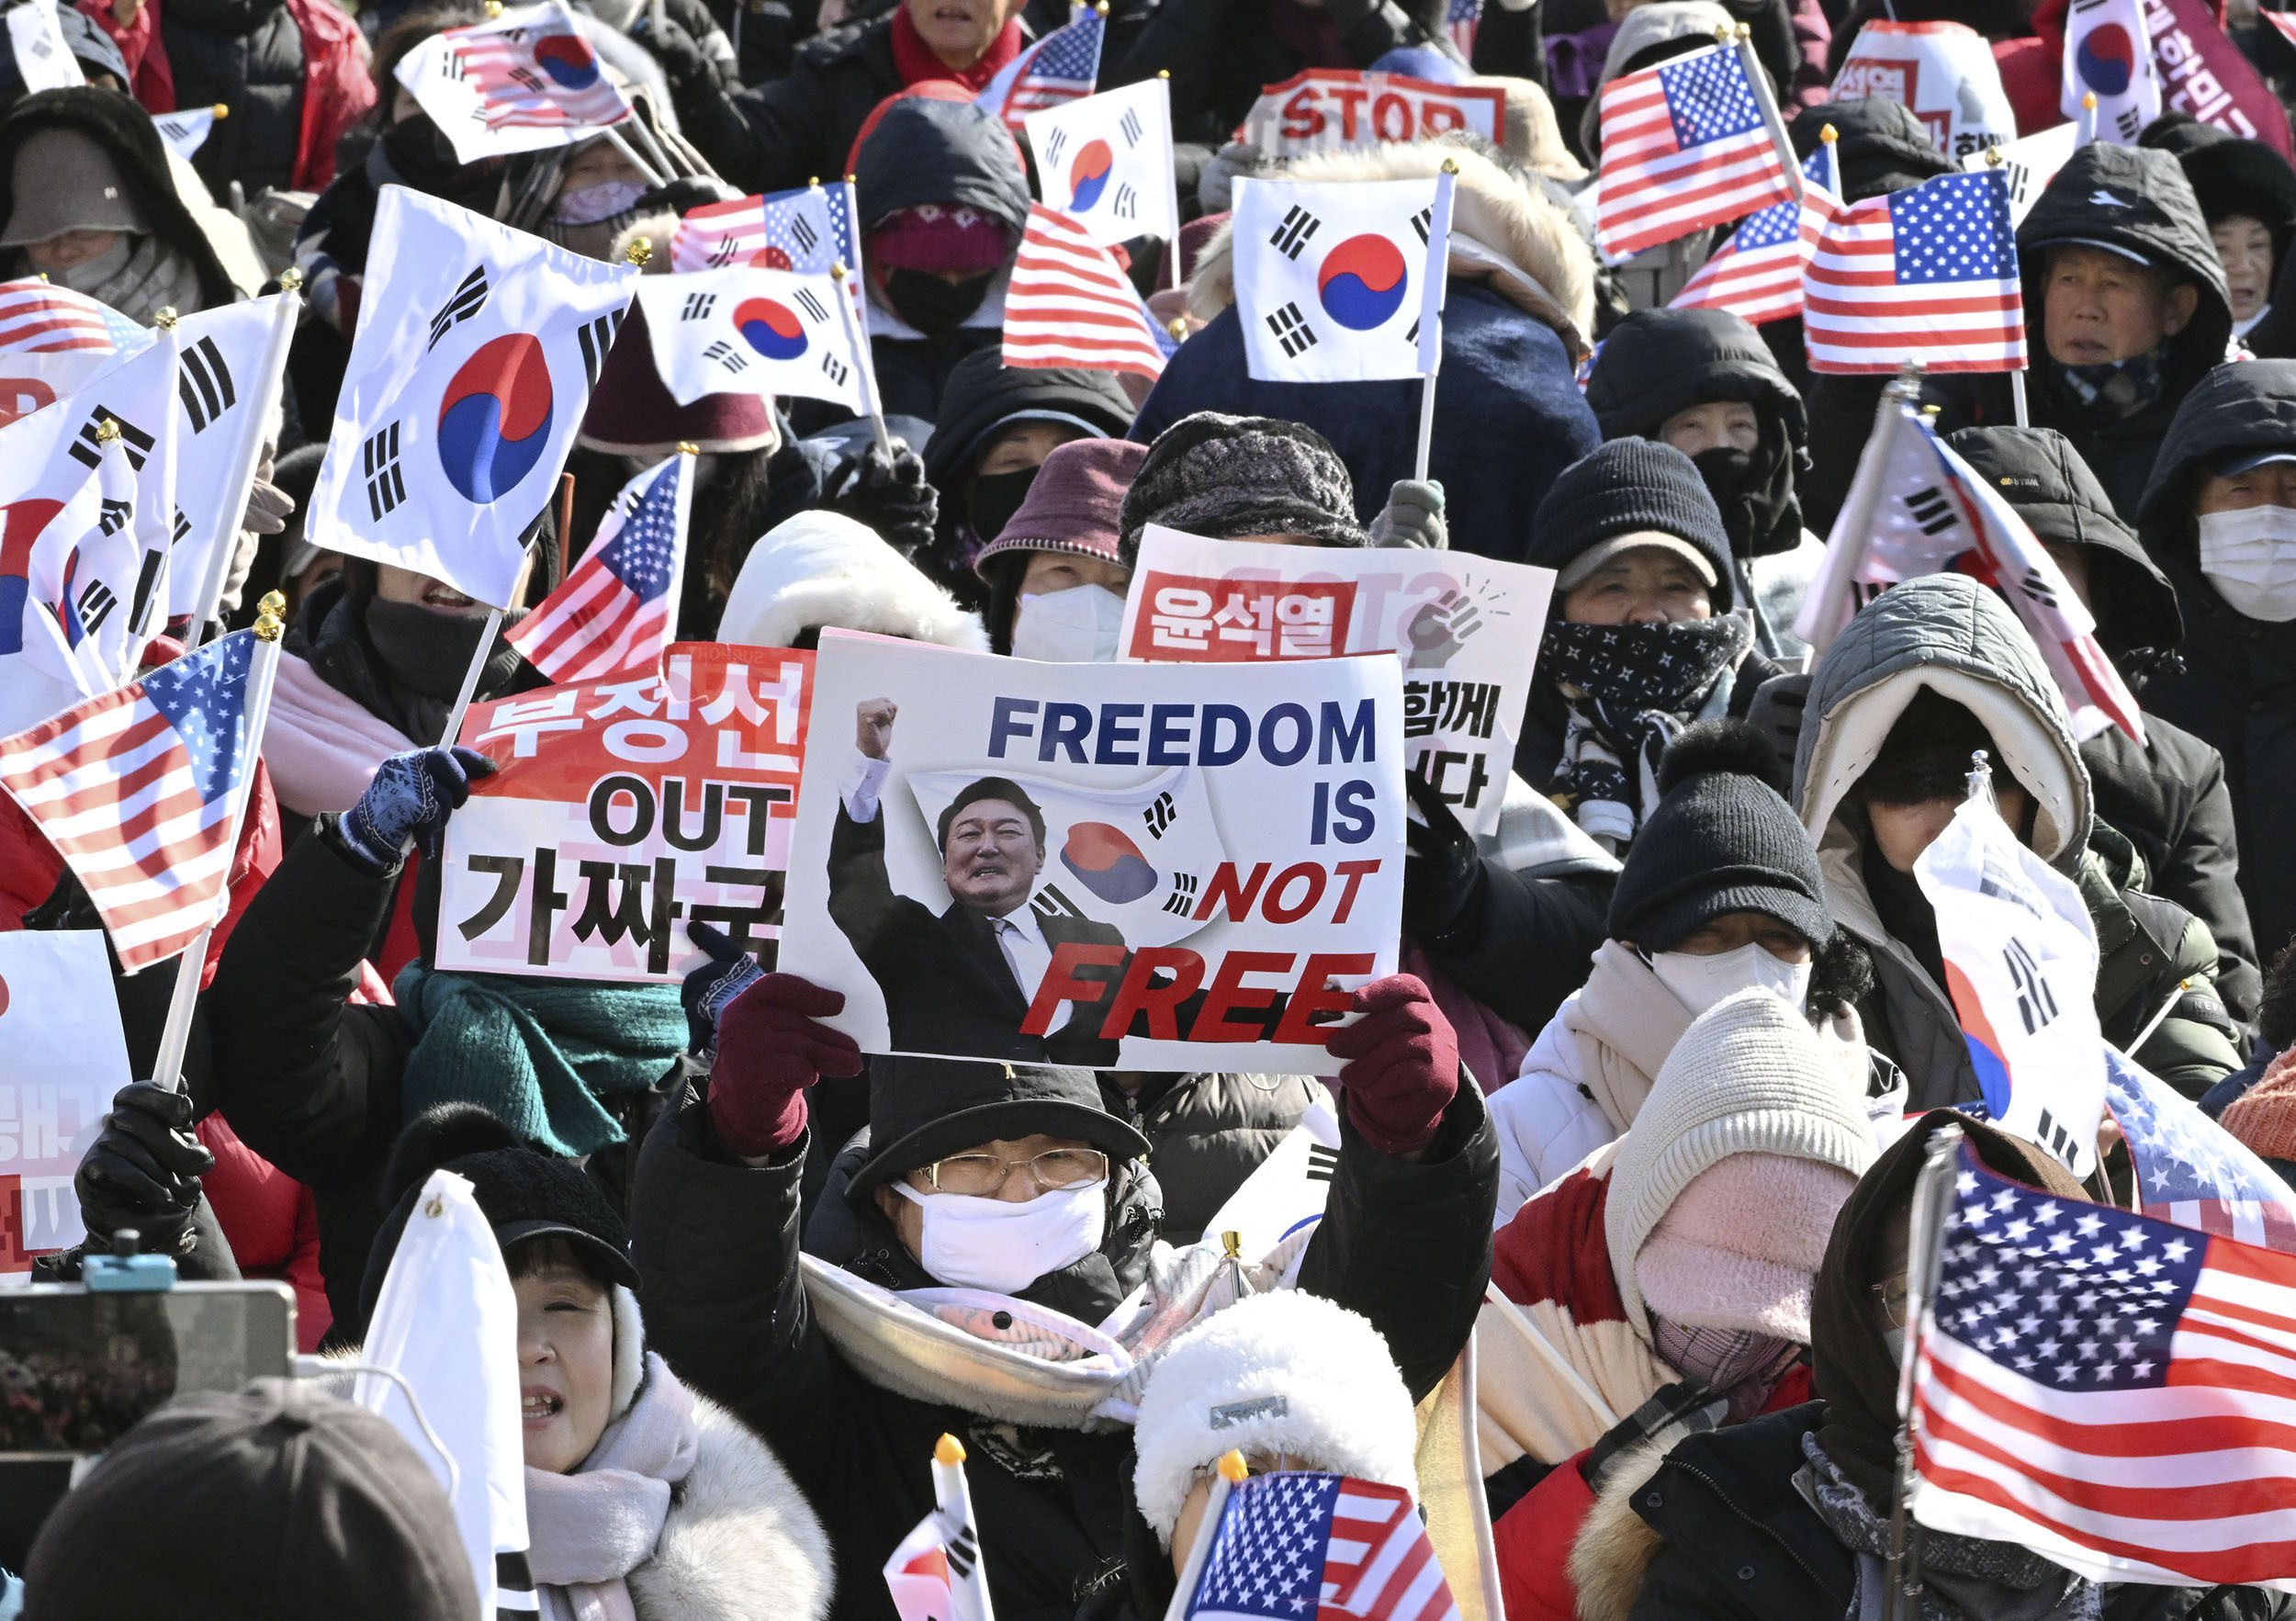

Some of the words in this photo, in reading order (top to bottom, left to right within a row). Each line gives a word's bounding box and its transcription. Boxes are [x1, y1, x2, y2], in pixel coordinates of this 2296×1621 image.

[1280, 88, 1466, 141] STOP
[1151, 587, 1334, 657] 윤석열
[987, 696, 1376, 767] FREEDOM
[1404, 681, 1502, 739] 함께
[589, 774, 792, 856] OUT
[1310, 780, 1376, 845] IS
[1191, 859, 1382, 925] NOT
[1019, 942, 1376, 1045] FREE
